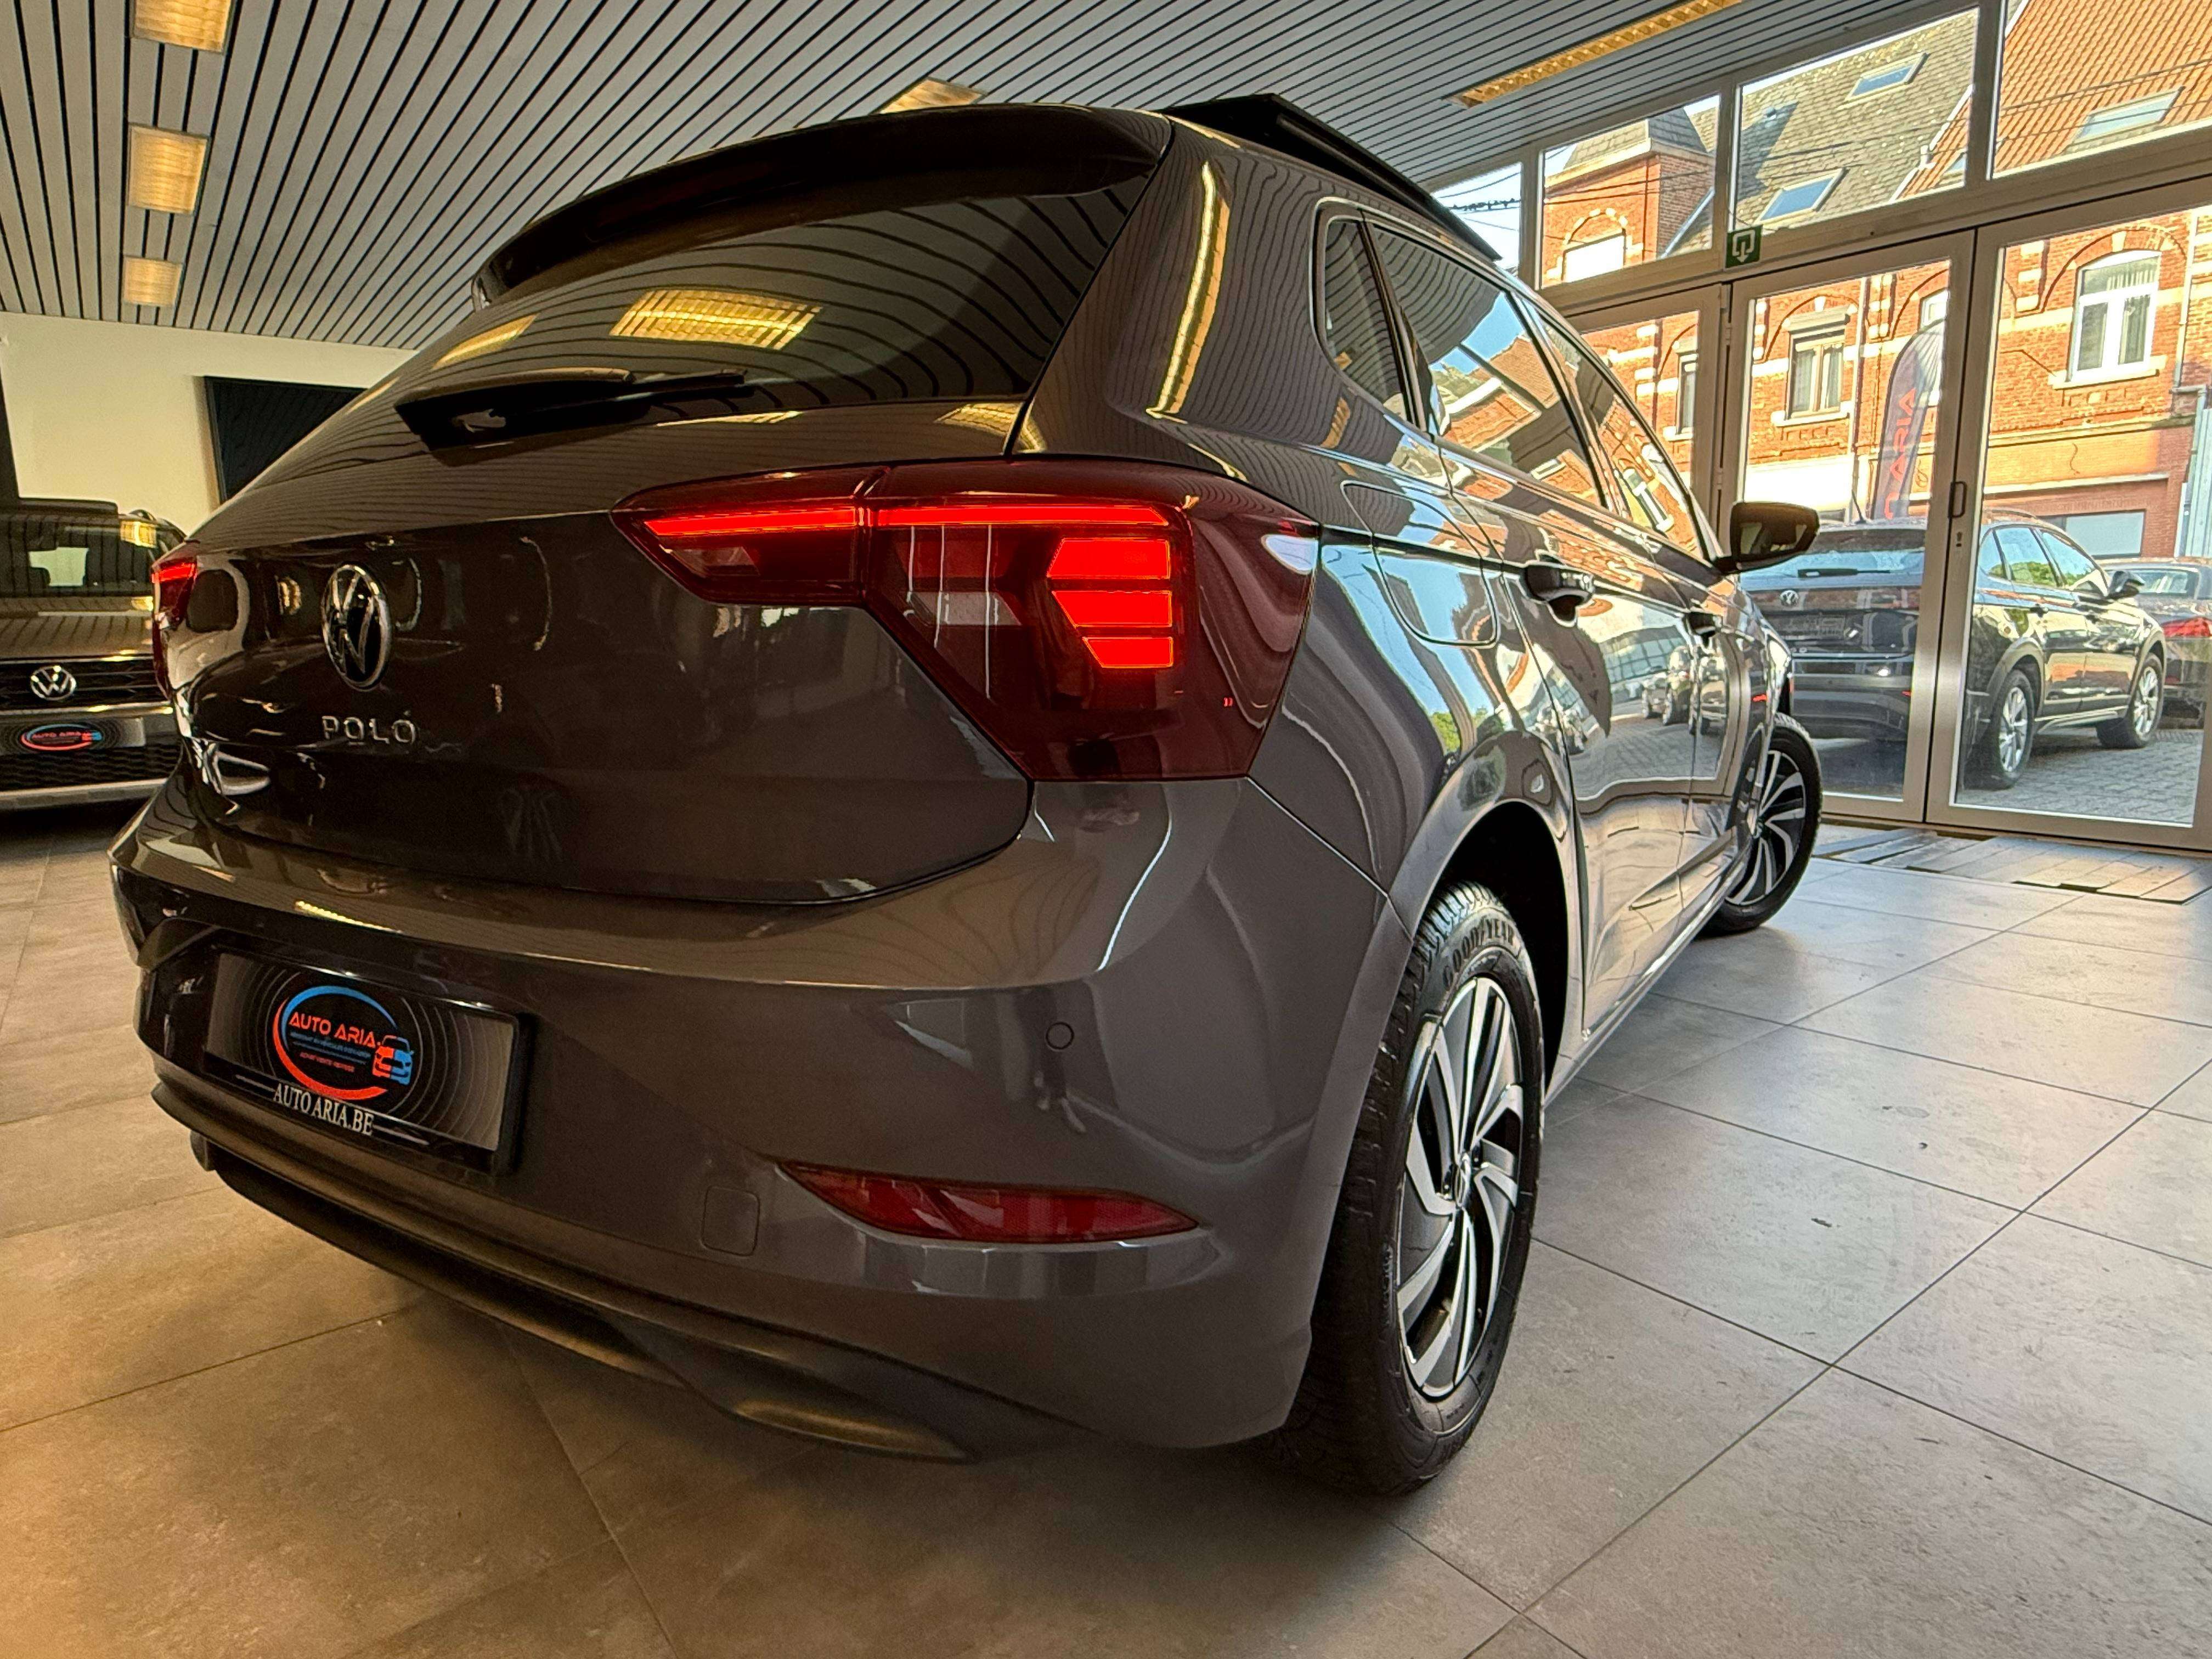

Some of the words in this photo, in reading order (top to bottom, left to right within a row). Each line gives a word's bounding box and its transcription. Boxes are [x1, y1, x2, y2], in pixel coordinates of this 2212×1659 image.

[1889, 387, 1916, 483] ARIA
[321, 715, 416, 745] POLO
[289, 1012, 331, 1035] AUTO
[334, 1024, 376, 1048] ARIA
[273, 1083, 312, 1114] AUTO
[311, 1097, 374, 1136] ARIA.BE
